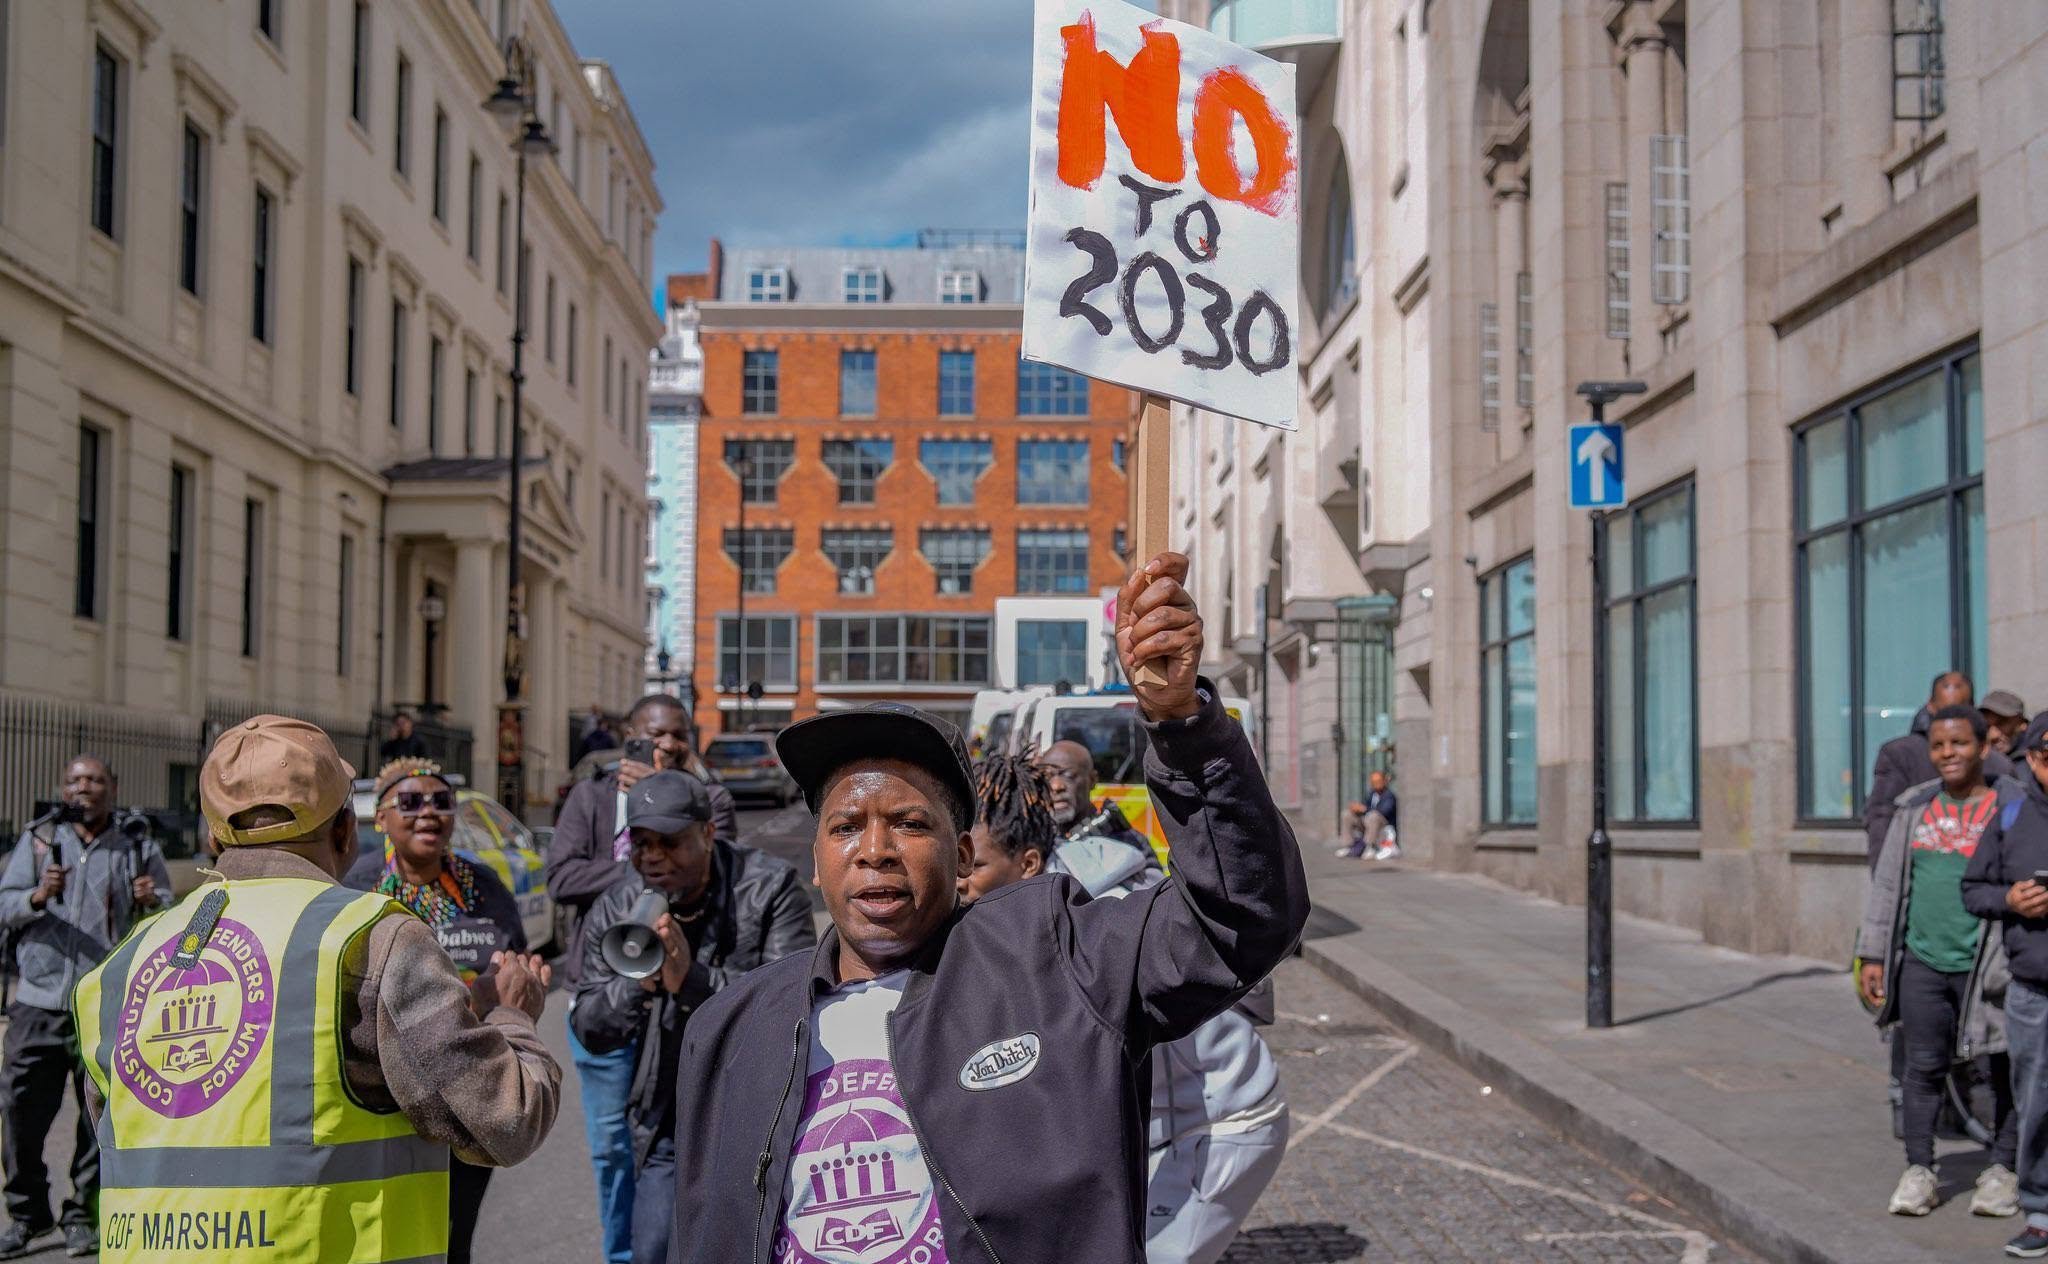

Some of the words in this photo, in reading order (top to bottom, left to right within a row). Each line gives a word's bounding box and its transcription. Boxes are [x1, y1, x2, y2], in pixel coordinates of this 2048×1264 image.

[1057, 9, 1297, 219] NO
[1119, 174, 1221, 264] TO
[1060, 226, 1290, 377] 2030
[208, 927, 265, 1004] FENDERS
[119, 951, 174, 1106] CONSTITUTION
[201, 1022, 260, 1099] FORUM
[820, 1071, 897, 1099] DEFE
[106, 1213, 135, 1250] CDF
[142, 1210, 275, 1250] MARSHAL
[824, 1220, 891, 1247] CDF
